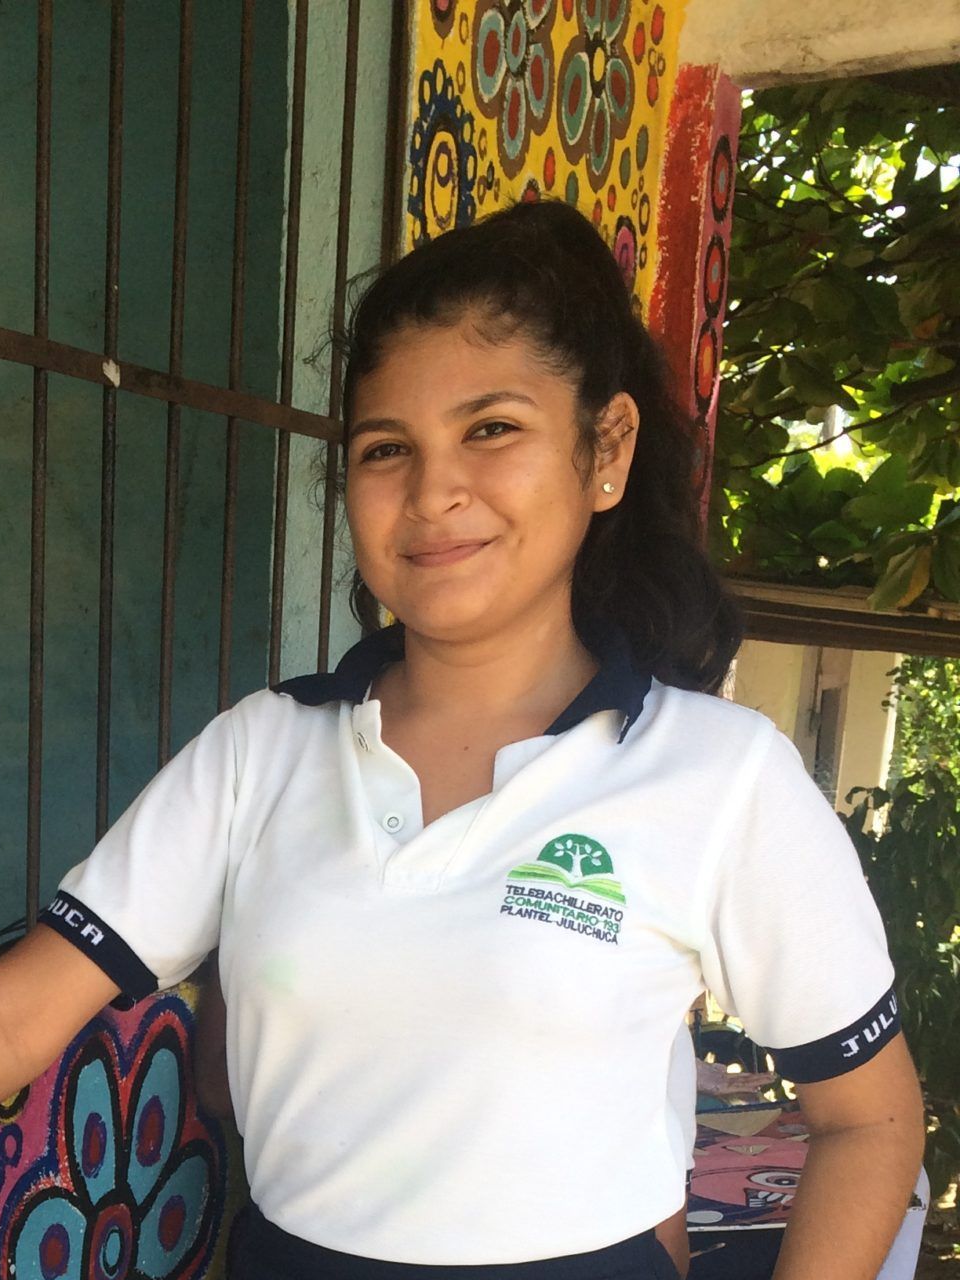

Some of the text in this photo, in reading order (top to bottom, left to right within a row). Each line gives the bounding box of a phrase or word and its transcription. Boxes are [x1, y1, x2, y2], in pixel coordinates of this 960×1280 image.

[47, 898, 104, 946] UCA
[503, 895, 599, 926] COMUNITARIO
[505, 884, 624, 922] TELEBACHILLERATO
[500, 905, 619, 945] PLANTEL JULUCHUCA
